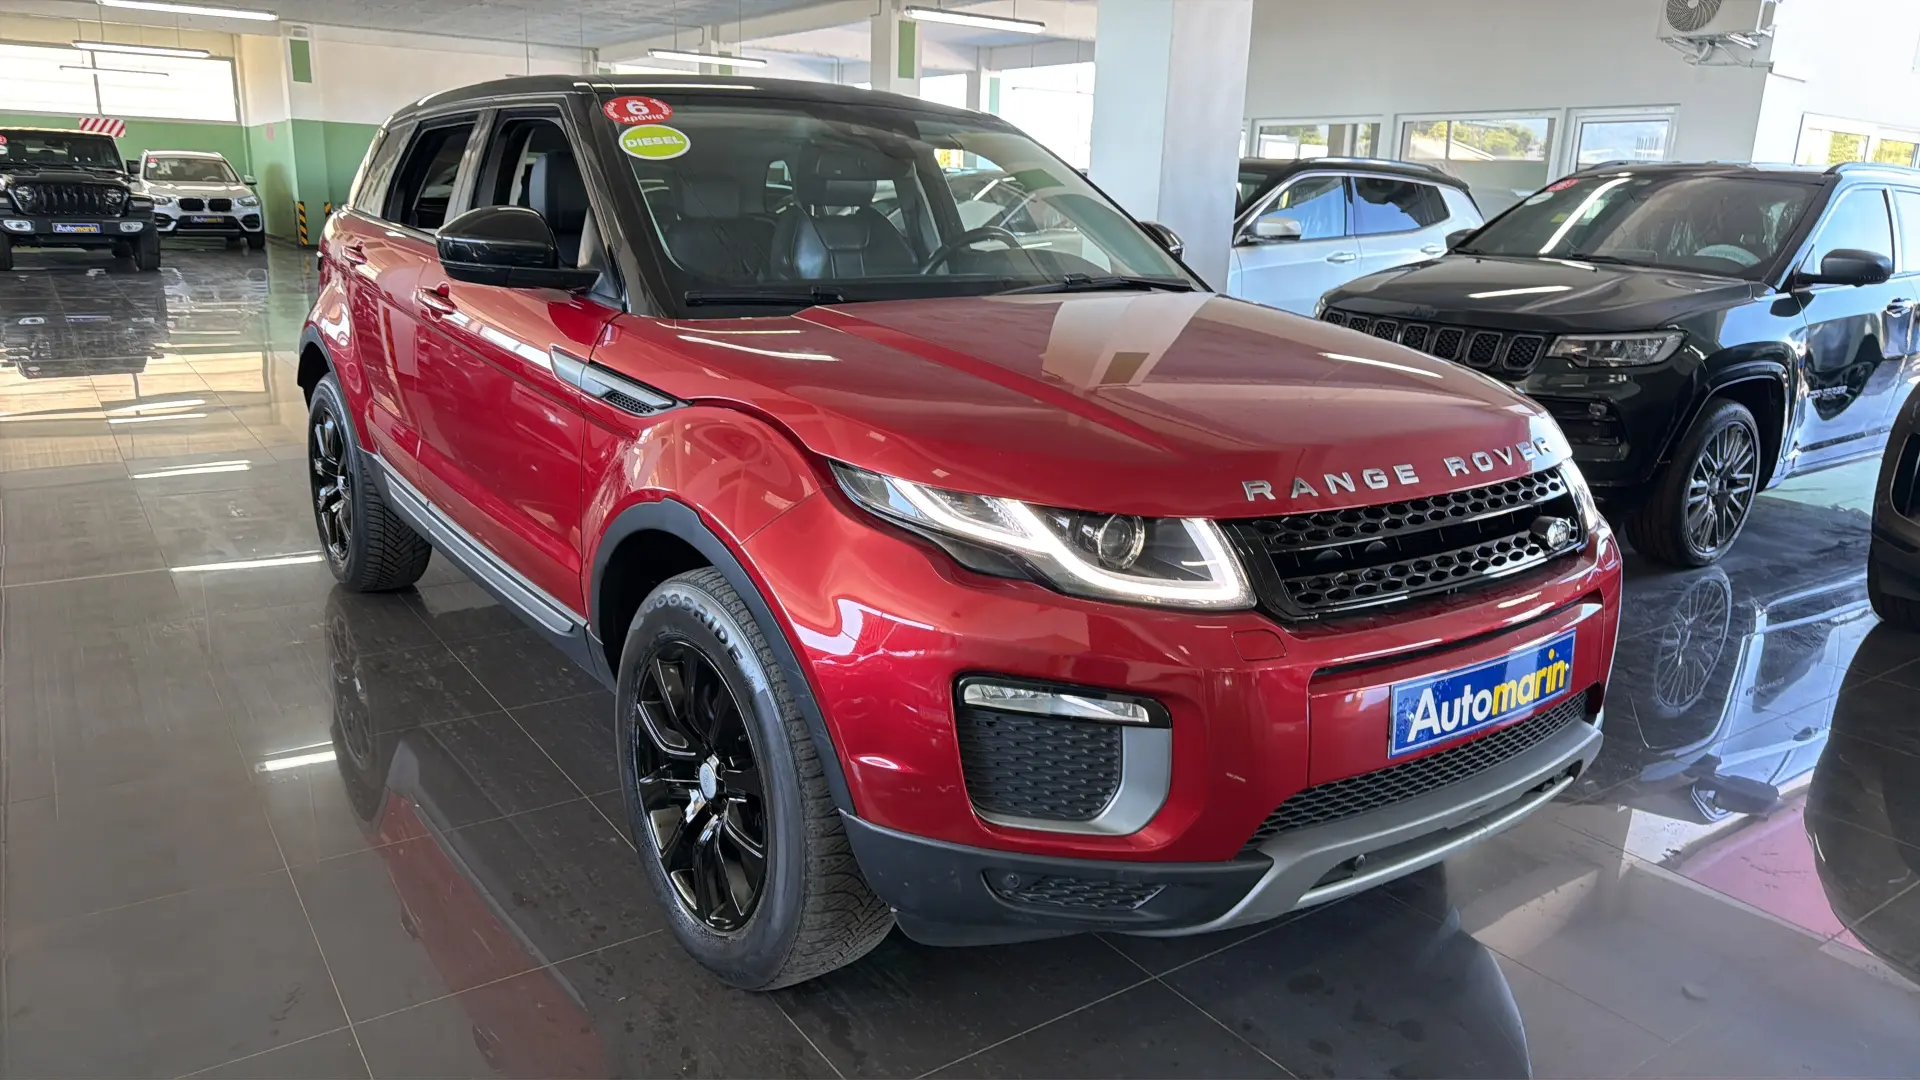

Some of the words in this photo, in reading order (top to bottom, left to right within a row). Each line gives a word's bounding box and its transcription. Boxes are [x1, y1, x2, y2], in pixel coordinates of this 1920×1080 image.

[626, 101, 650, 115] 6
[625, 136, 684, 148] DIESEL
[56, 224, 98, 233] Automarin
[1241, 463, 1420, 501] RANGE
[1443, 436, 1552, 477] ROVER
[645, 593, 744, 668] GOODRIDE
[1406, 648, 1566, 743] Automarin
